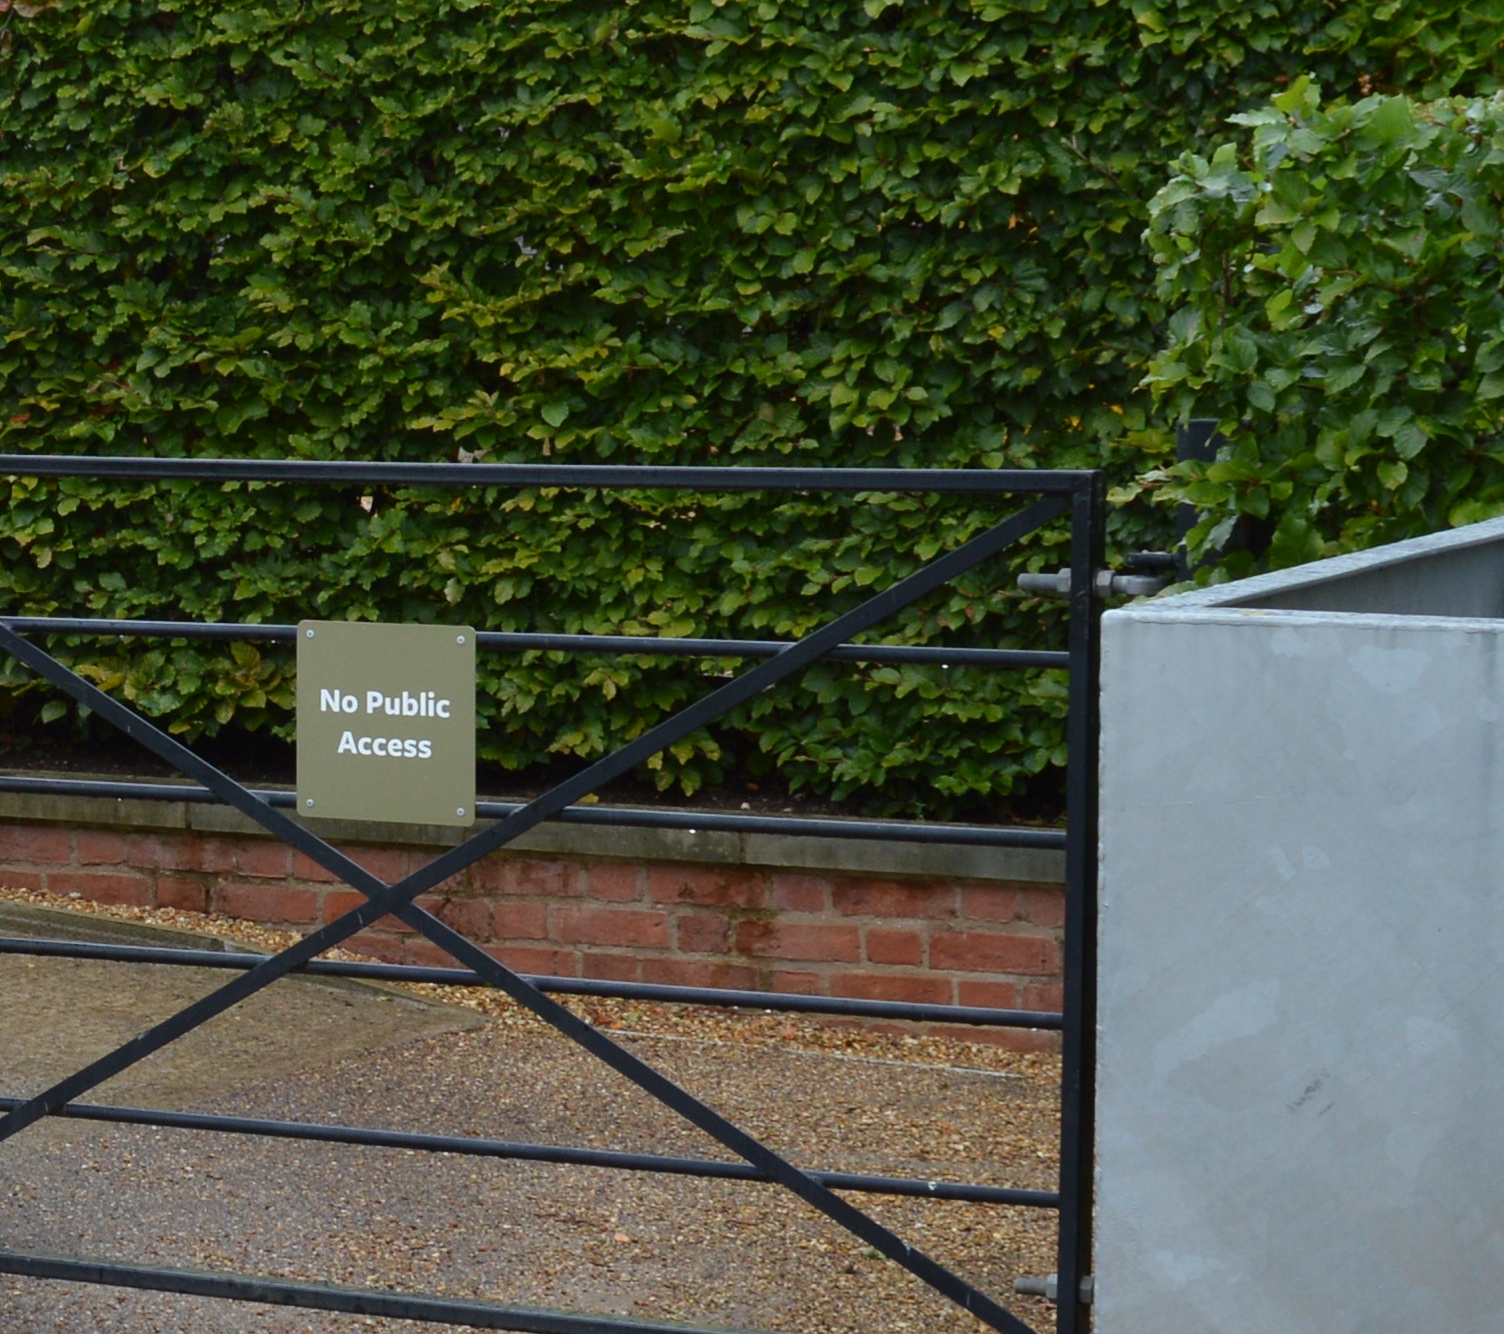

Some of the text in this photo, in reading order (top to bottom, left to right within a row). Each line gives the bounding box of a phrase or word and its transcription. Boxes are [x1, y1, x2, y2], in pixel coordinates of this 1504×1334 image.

[320, 688, 451, 718] No Public
[337, 730, 432, 759] Access
